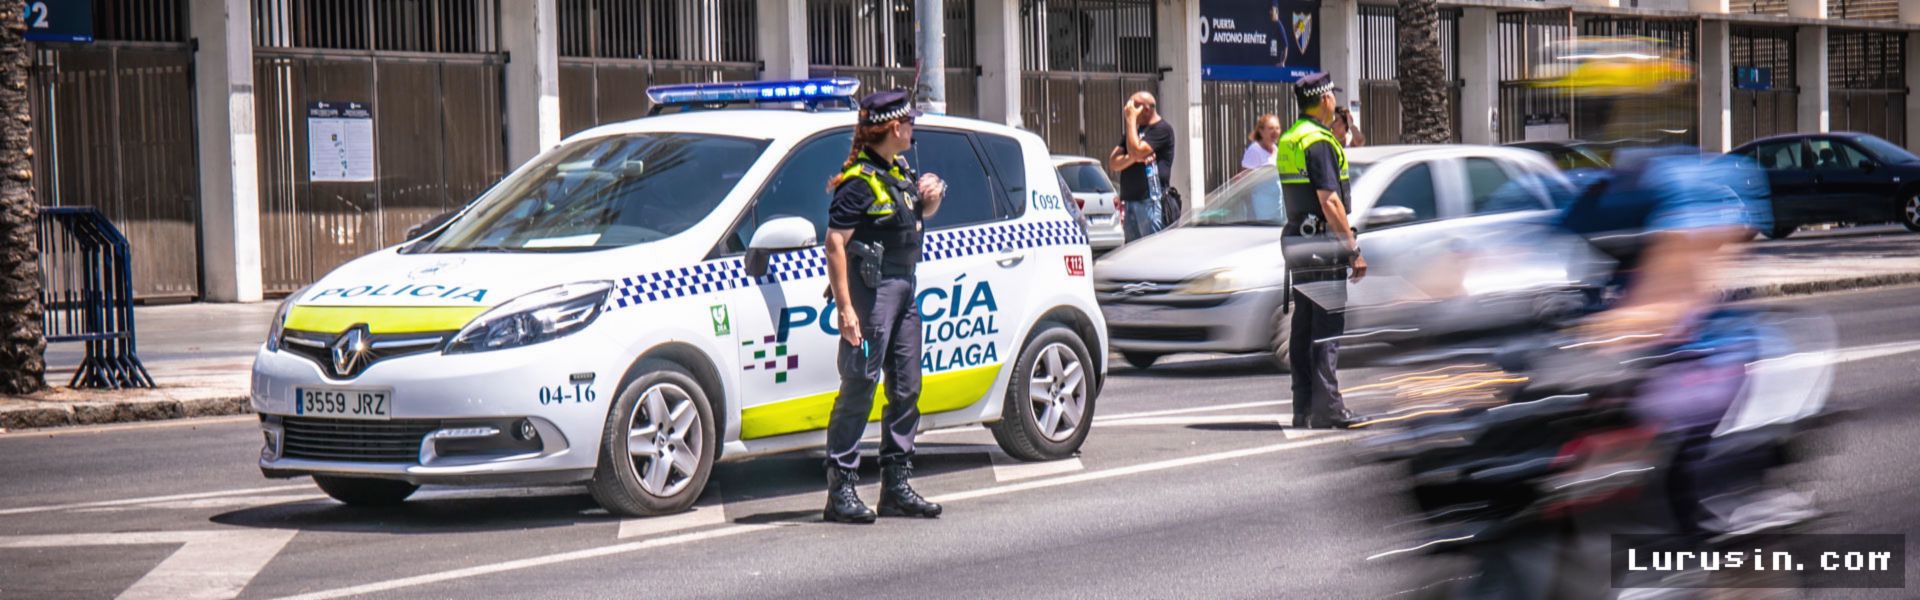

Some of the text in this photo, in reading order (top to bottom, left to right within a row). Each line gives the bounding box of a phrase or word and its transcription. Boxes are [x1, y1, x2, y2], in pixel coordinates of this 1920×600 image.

[1212, 18, 1236, 30] PUERTA
[1212, 30, 1267, 45] ANTONIO BENÍTEZ
[1039, 195, 1061, 210] 092
[1070, 256, 1083, 270] 112
[310, 284, 488, 303] POLICIA
[924, 314, 999, 344] LOCAL
[921, 341, 998, 373] ÁLAGA
[305, 391, 385, 415] 3559 JRZ
[539, 383, 596, 405] 04-16
